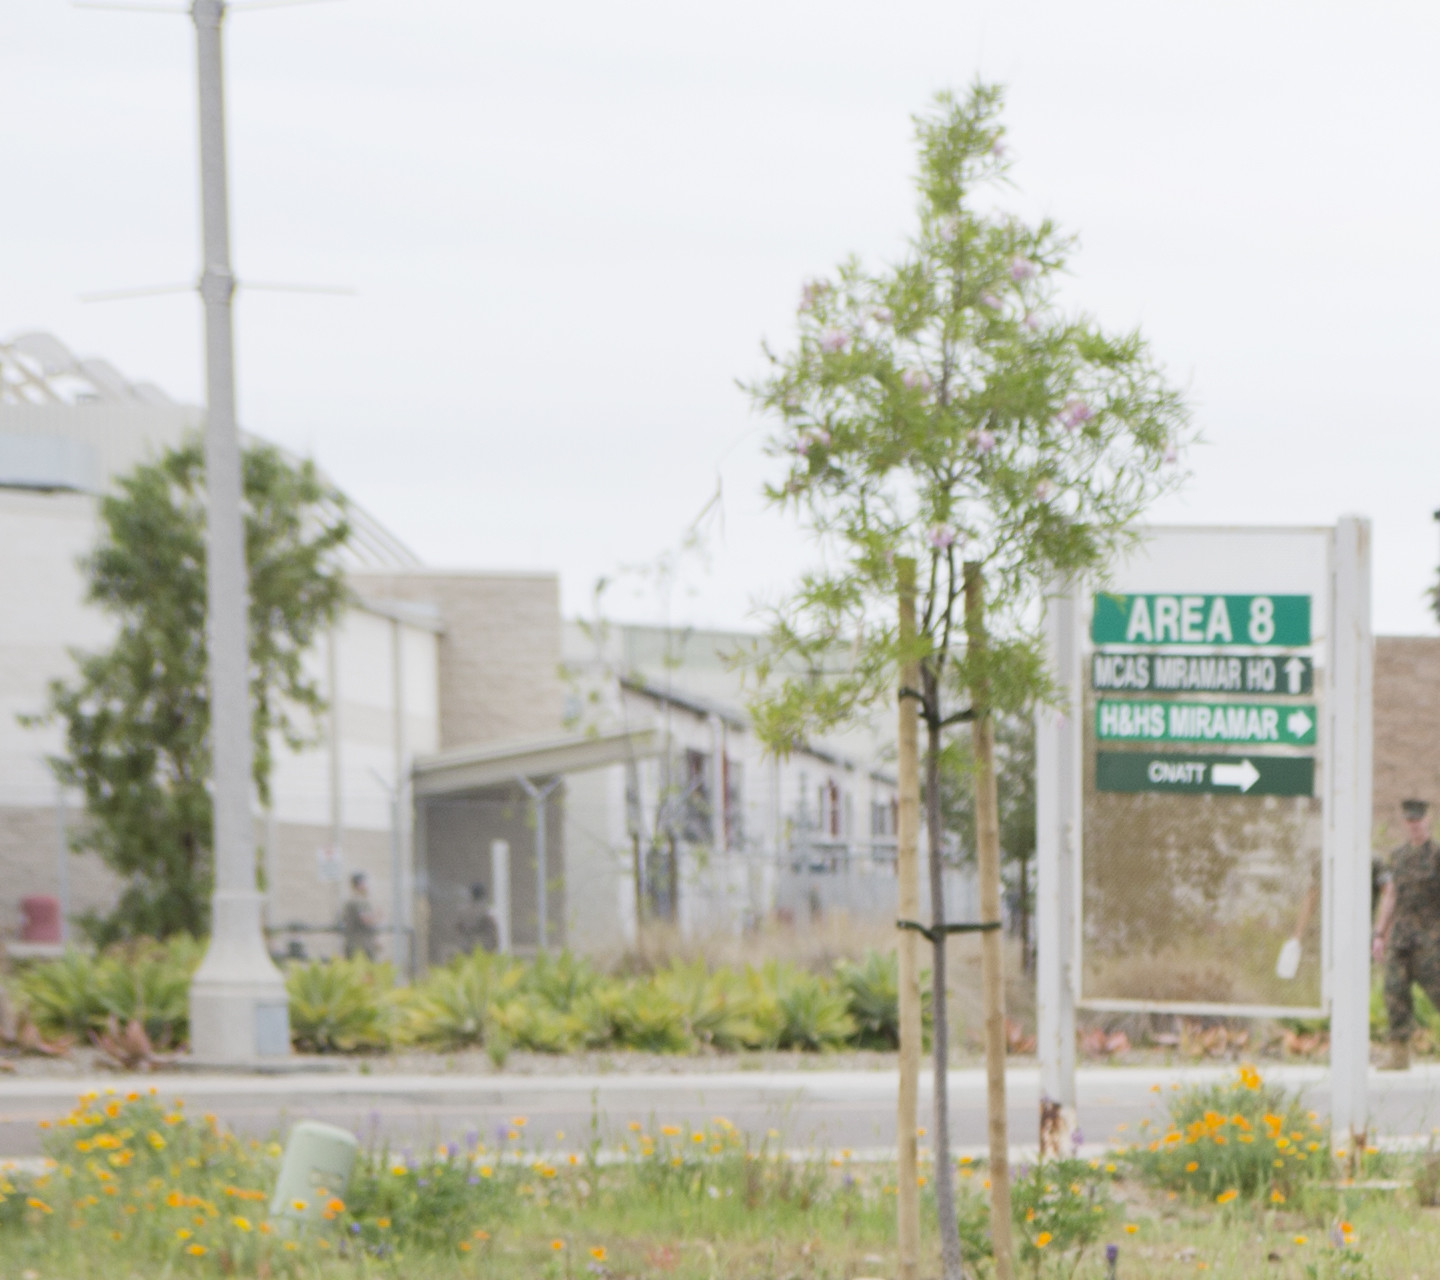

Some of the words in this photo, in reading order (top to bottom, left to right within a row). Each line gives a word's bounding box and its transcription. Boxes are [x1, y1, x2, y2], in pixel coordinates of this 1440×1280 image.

[1126, 597, 1233, 642] AREA
[1248, 597, 1276, 643] 8
[1094, 656, 1150, 689] MCAS
[1154, 657, 1242, 690] MIRAMAR
[1246, 658, 1276, 691] HQ
[1100, 703, 1165, 737] H&HS
[1169, 706, 1279, 740] MIRAMAR
[1149, 760, 1206, 783] CNATT
